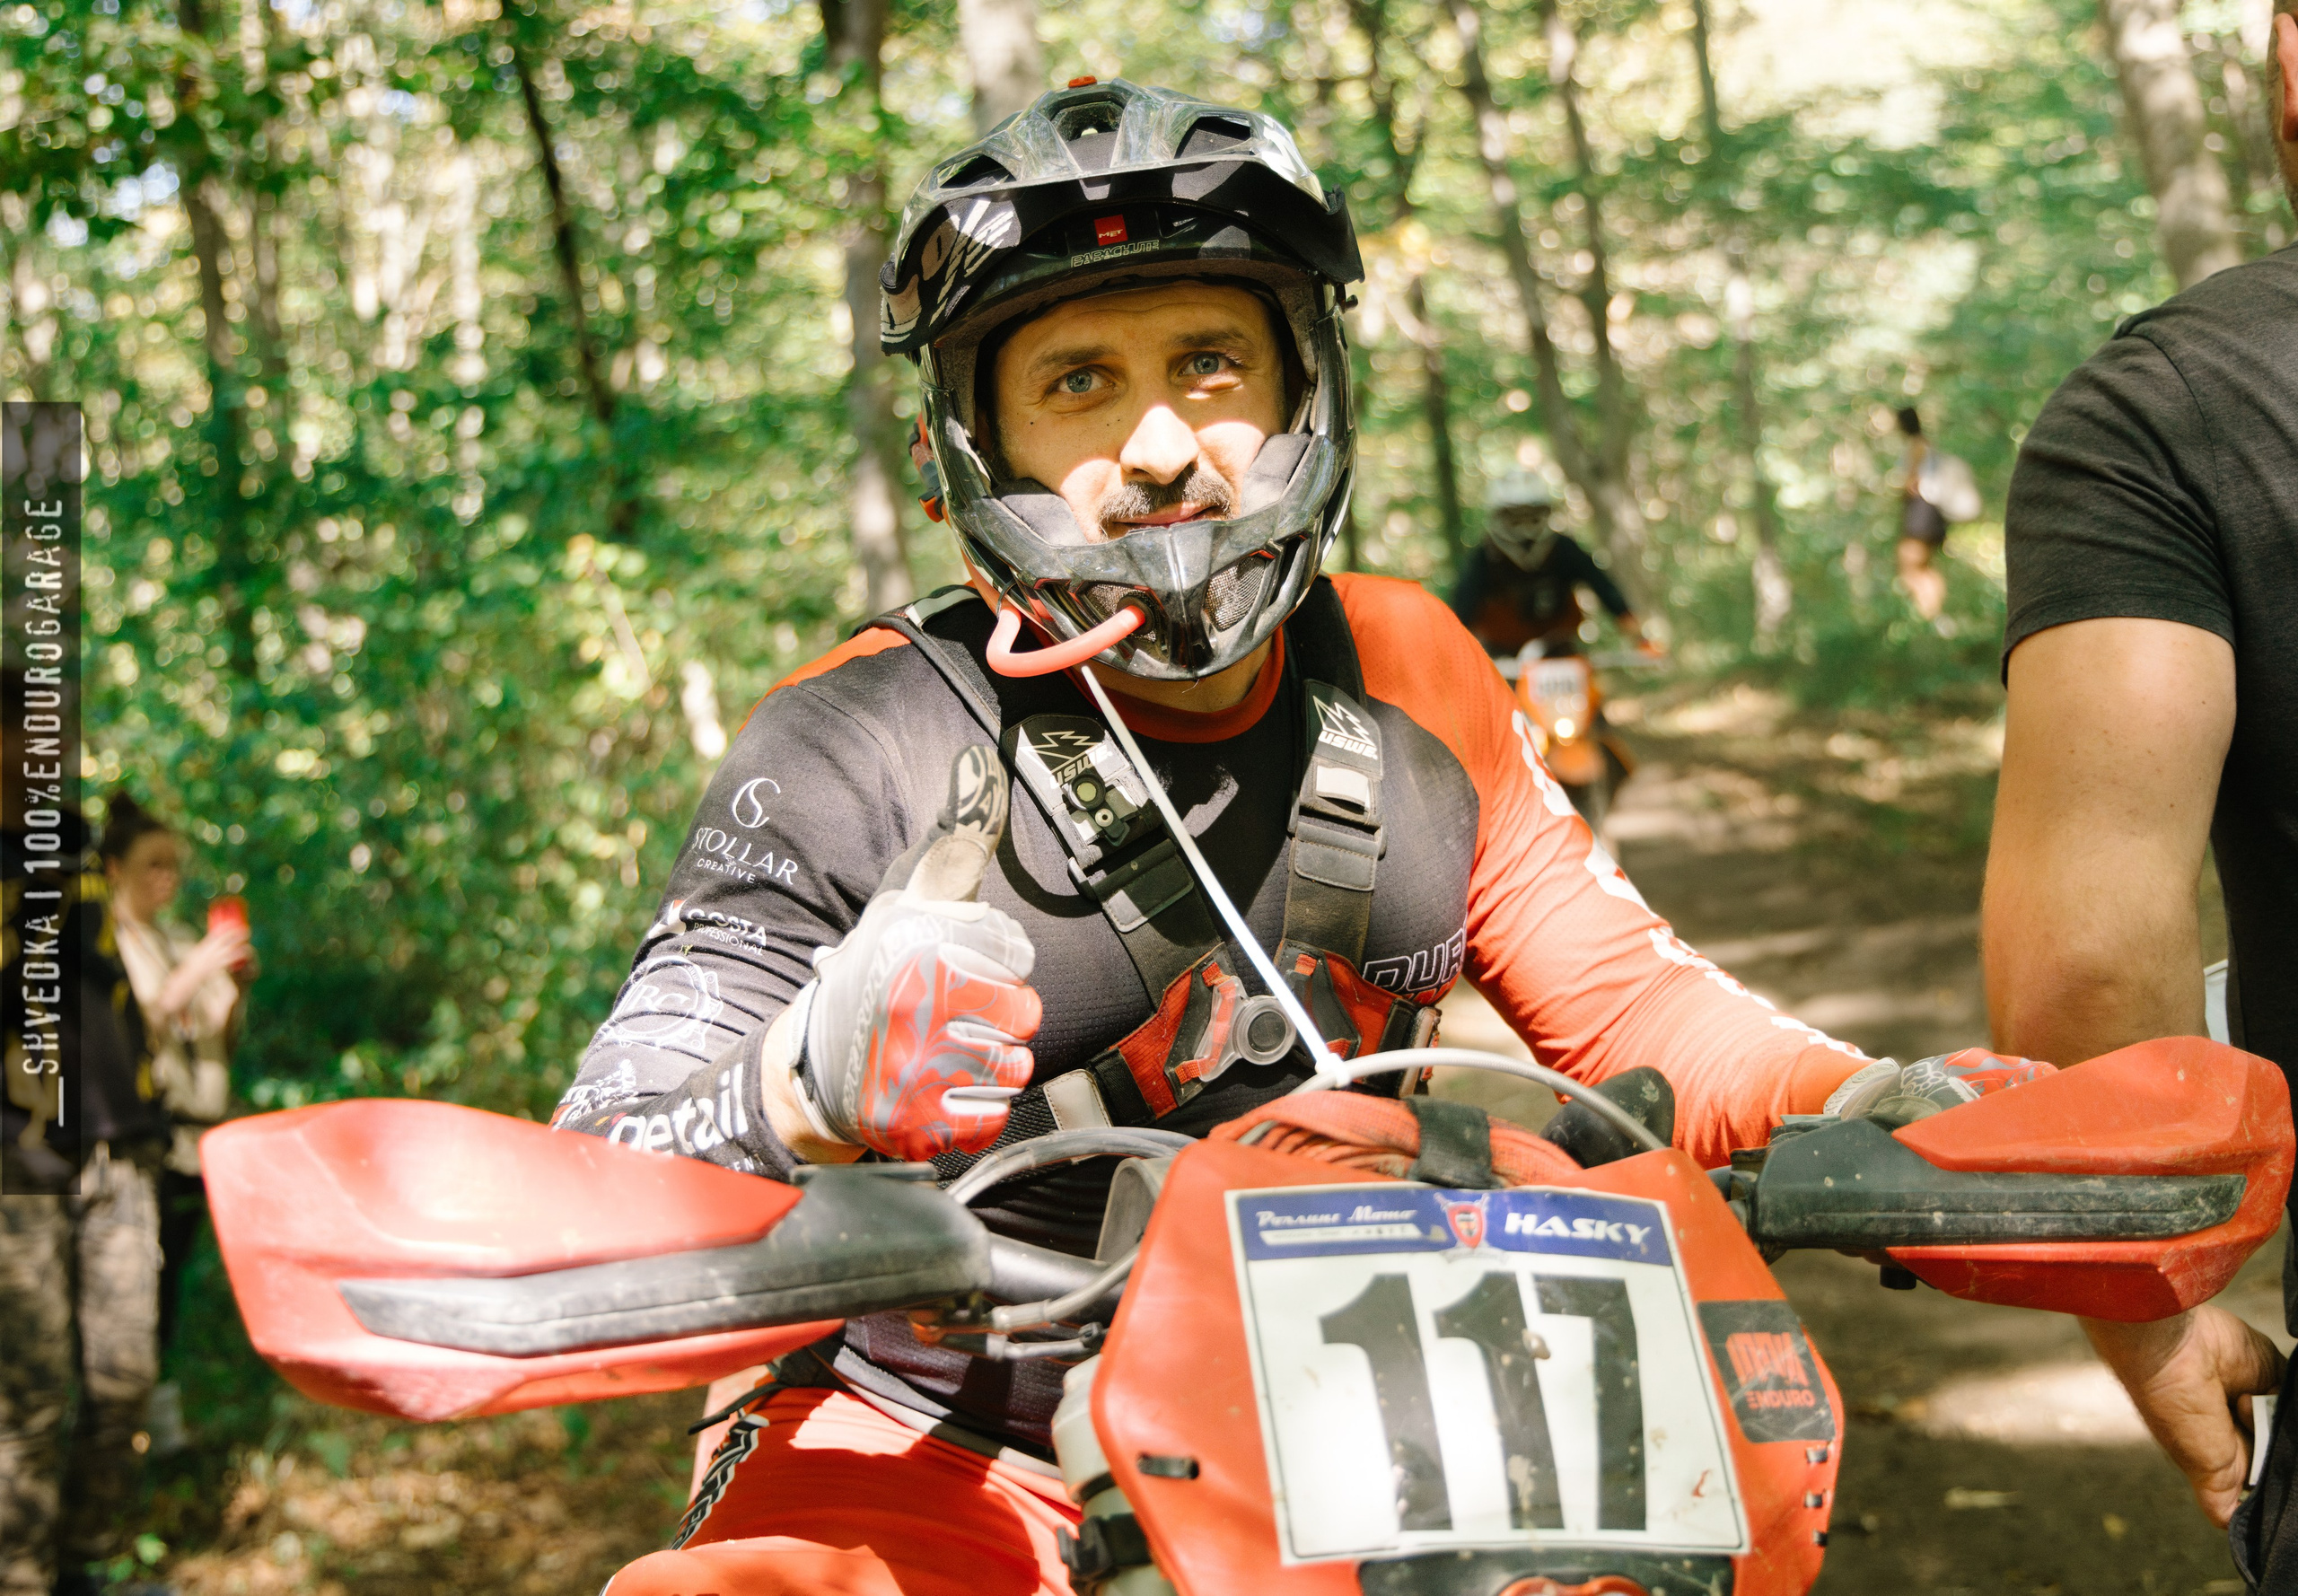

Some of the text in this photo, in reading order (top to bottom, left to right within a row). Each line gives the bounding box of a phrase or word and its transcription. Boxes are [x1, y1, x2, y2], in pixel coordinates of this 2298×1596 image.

[1098, 229, 1123, 239] MET
[1071, 240, 1159, 267] PARACHUTE
[692, 828, 798, 885] STOLLAR
[697, 858, 756, 884] CREATIVE
[693, 922, 763, 956] PROFESSIONAL
[1504, 1212, 1652, 1245] HASKY
[1318, 1270, 1648, 1531] 117
[1745, 1389, 1816, 1410] ENDURO
